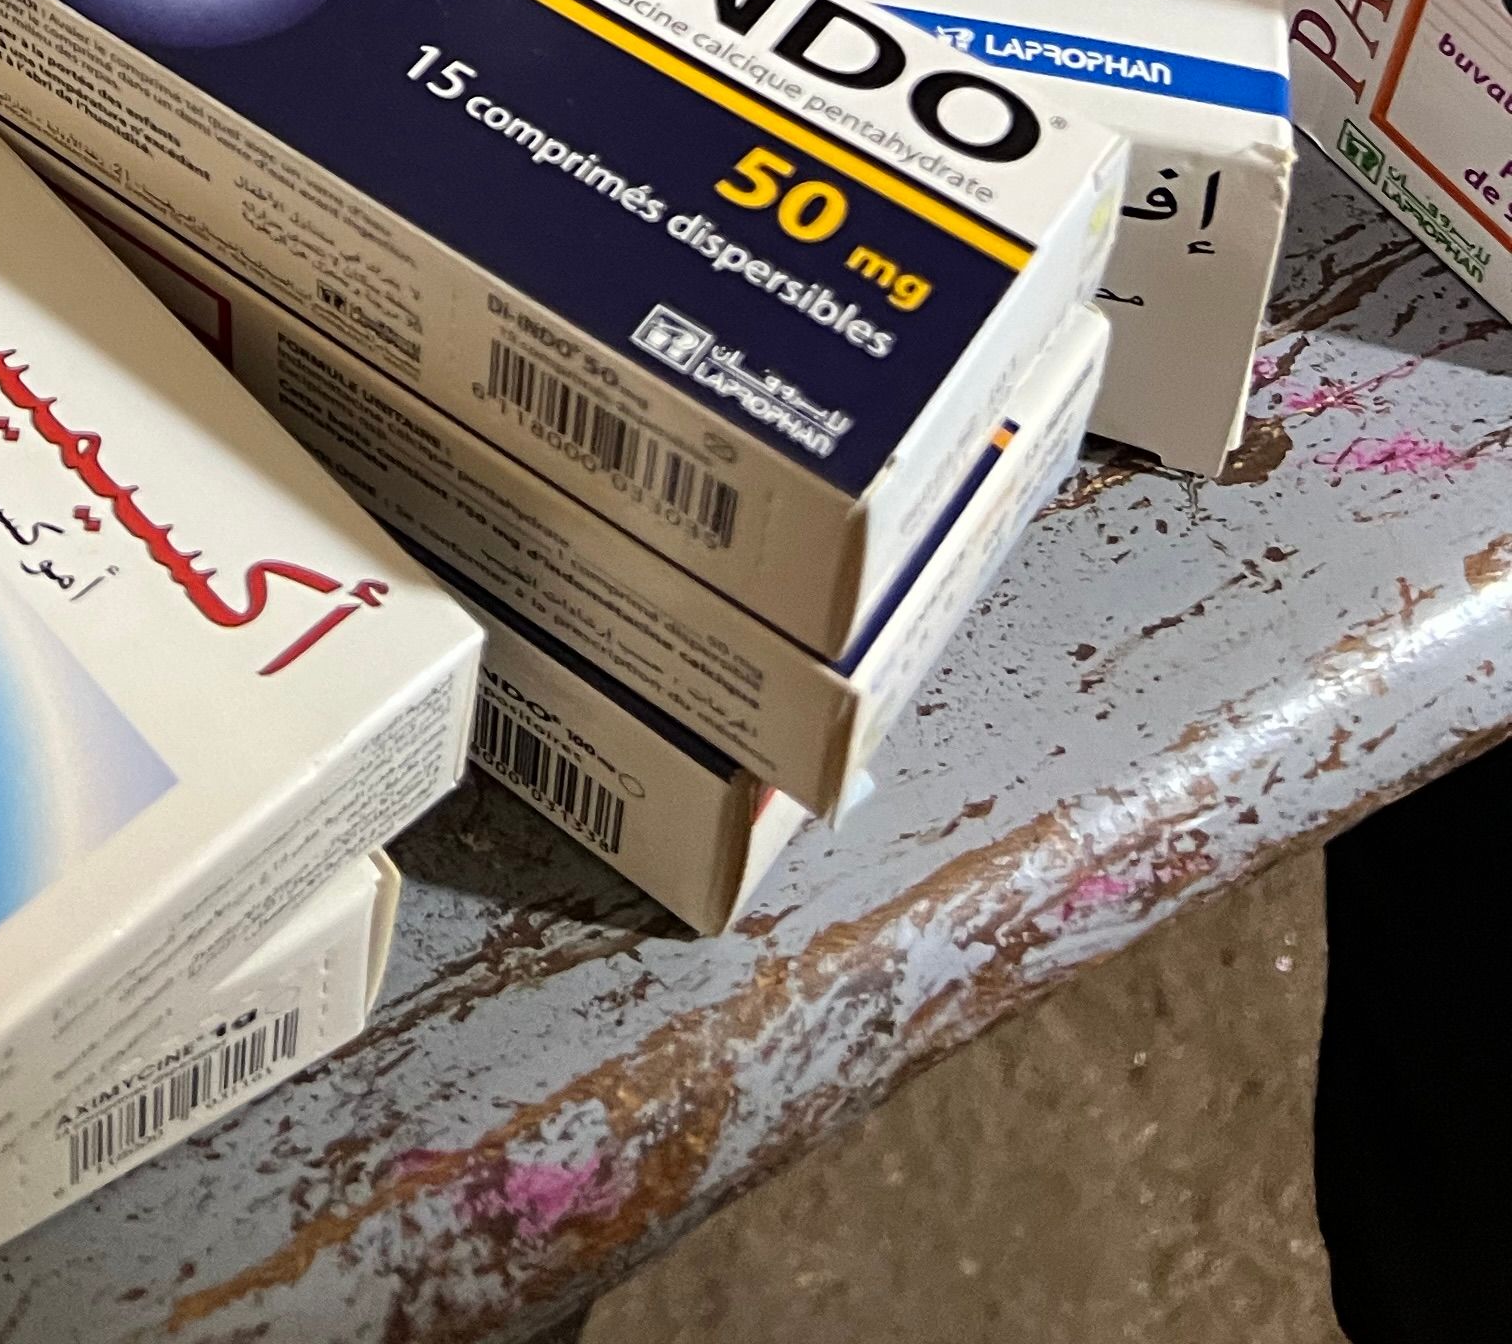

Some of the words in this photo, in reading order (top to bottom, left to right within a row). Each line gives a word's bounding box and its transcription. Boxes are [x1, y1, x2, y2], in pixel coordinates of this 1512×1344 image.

[692, 33, 802, 98] calcique
[803, 96, 993, 202] pentahydrate
[986, 35, 1171, 84] LAPROPHAN
[408, 45, 476, 98] 15
[467, 97, 664, 221] comprimés
[668, 215, 890, 356] dispersibles
[717, 148, 846, 241] 50
[847, 247, 930, 310] mg
[694, 362, 832, 455] LAPROPHAN
